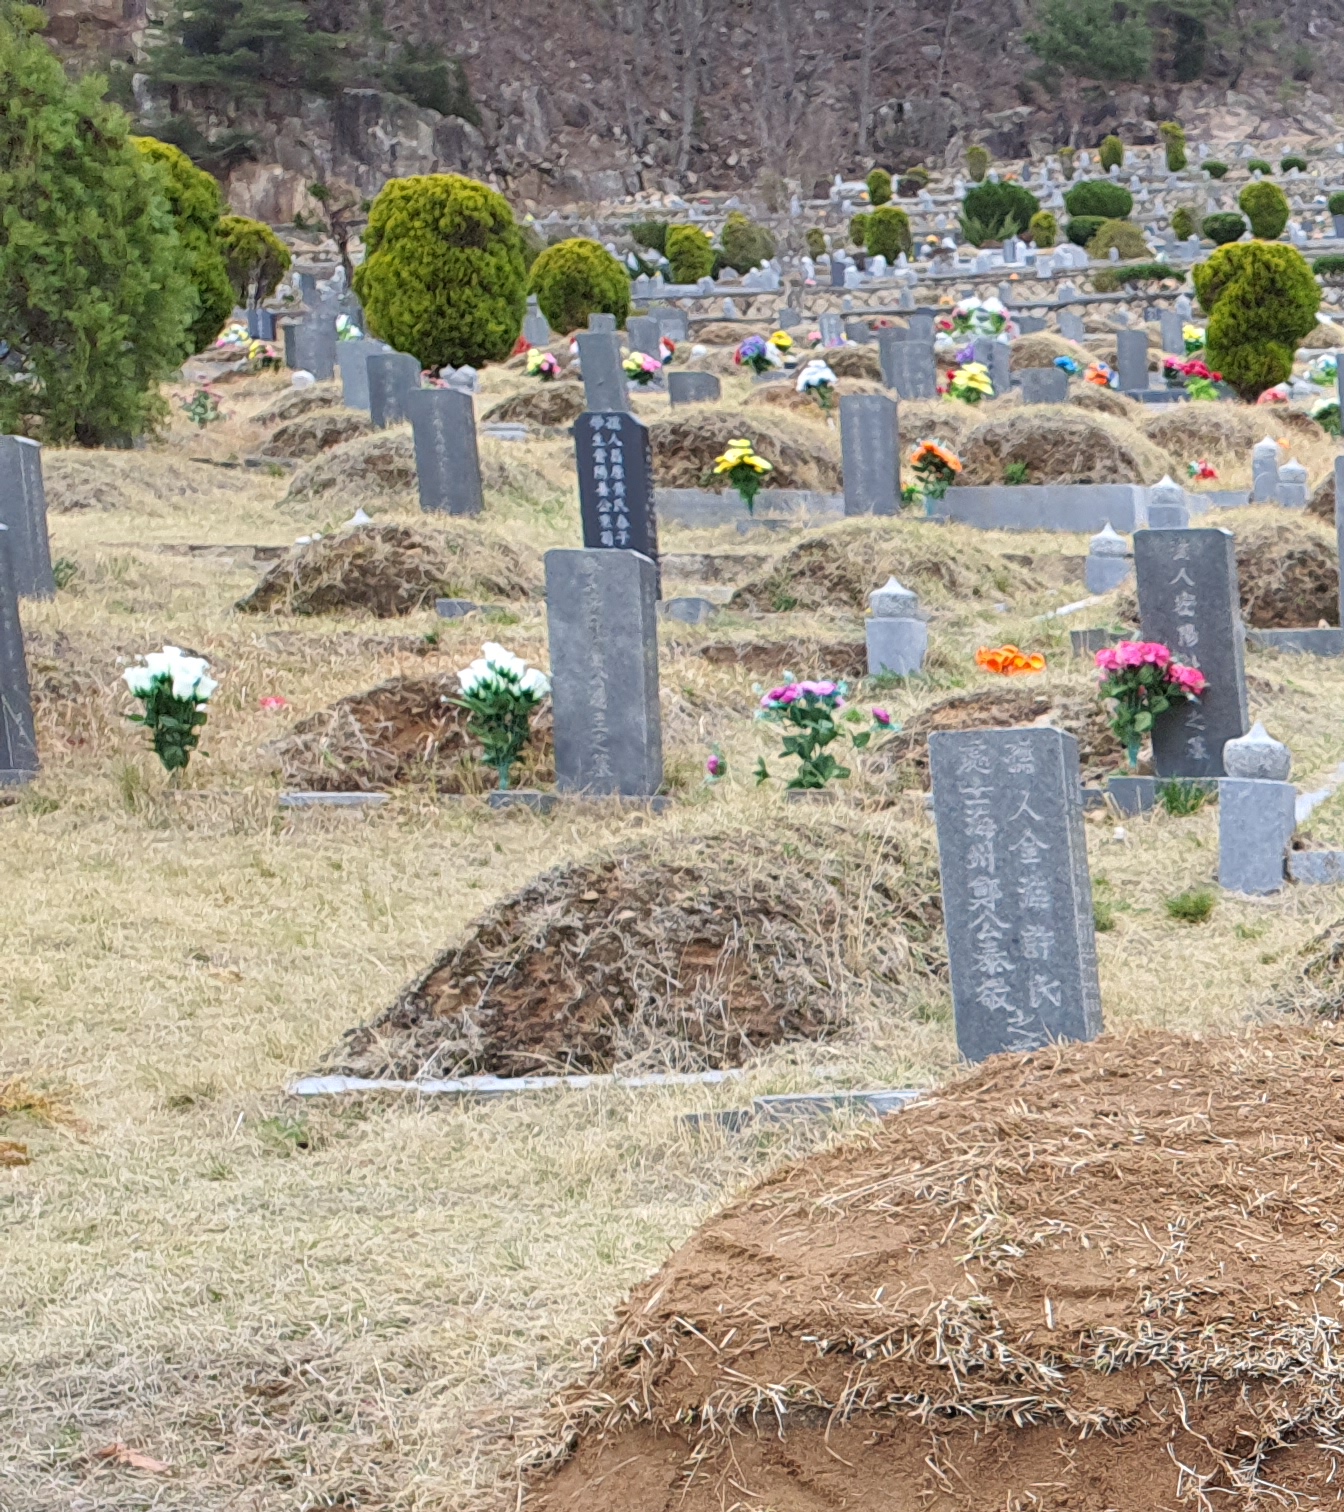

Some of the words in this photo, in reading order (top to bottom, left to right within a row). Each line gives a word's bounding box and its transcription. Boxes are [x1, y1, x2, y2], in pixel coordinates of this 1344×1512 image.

[1004, 740, 1062, 1007] 孺人金海許氏
